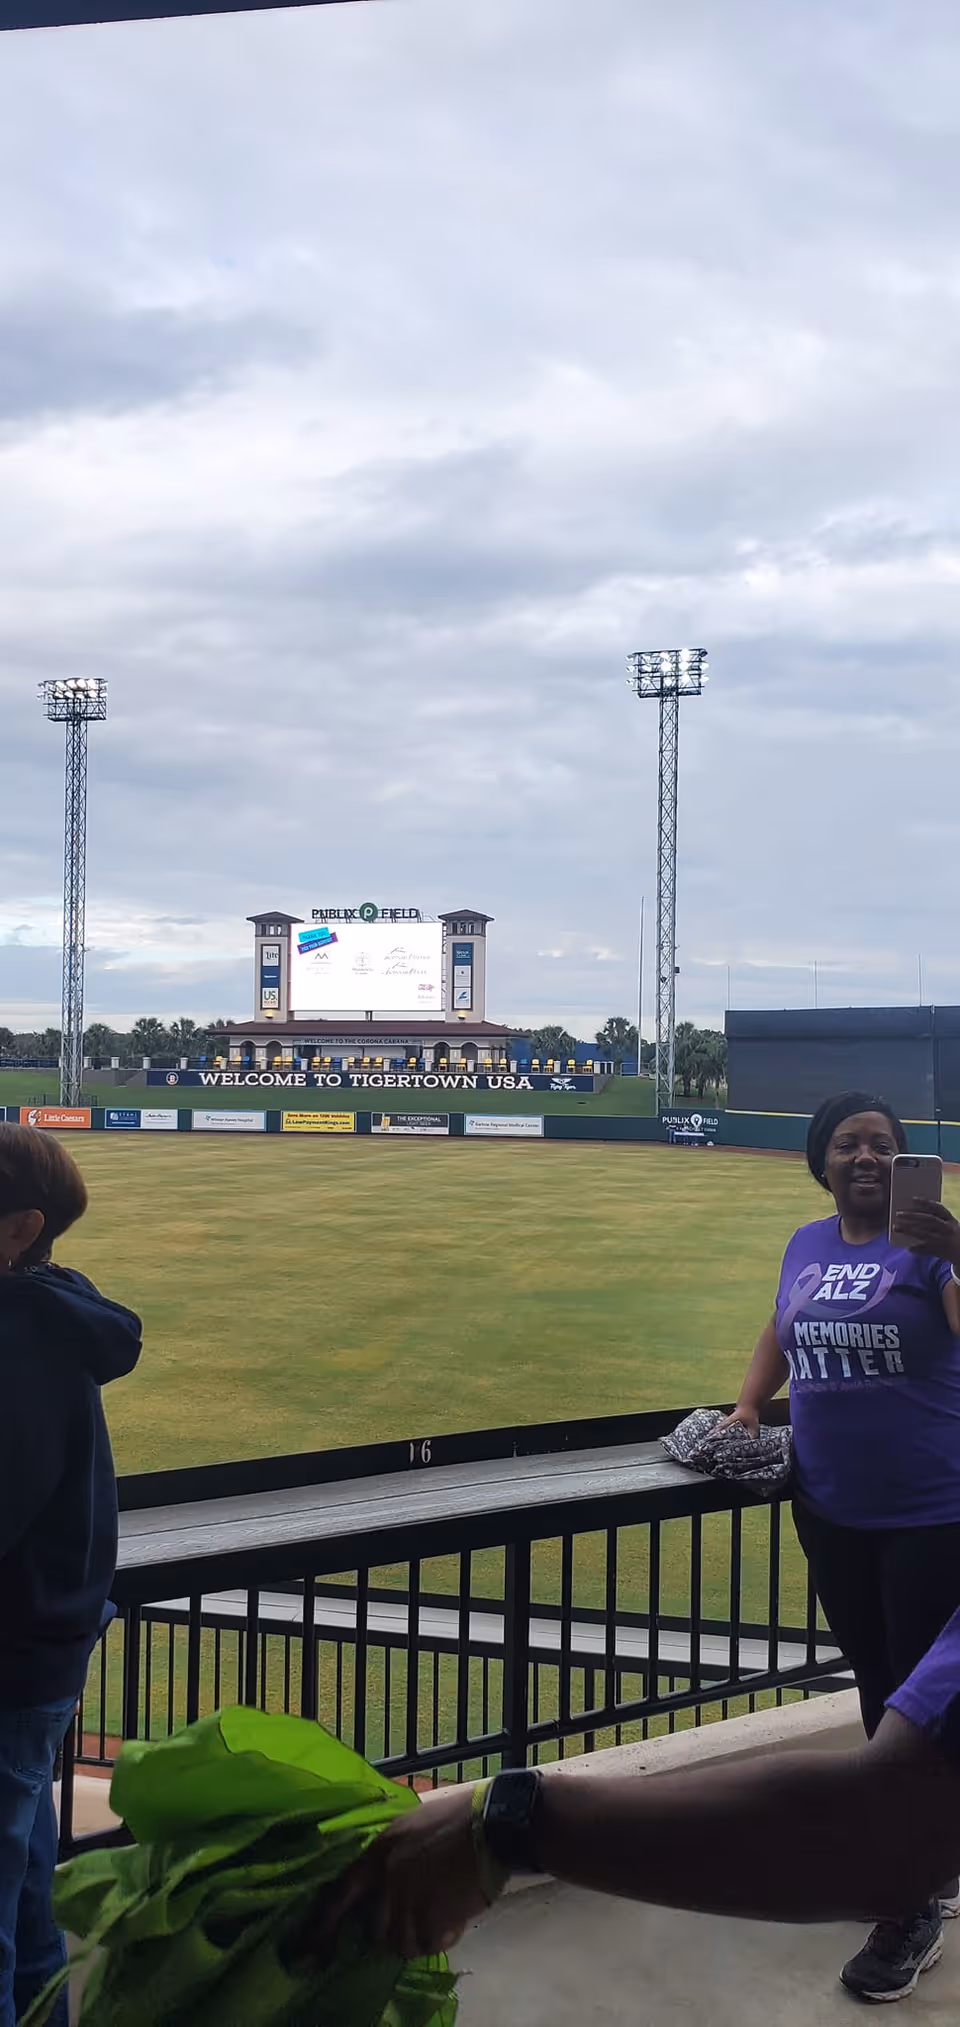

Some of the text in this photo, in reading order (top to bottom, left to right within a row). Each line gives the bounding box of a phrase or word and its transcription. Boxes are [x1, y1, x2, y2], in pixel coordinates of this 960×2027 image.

[312, 908, 357, 919] PUBLIX
[381, 908, 418, 919] FIELD
[199, 1072, 534, 1090] WELCOME TO TIGERTOWN USA
[44, 1113, 85, 1123] Little Caesars
[662, 1116, 719, 1125] PUBLIX FIELD
[821, 1262, 881, 1282] END
[812, 1280, 871, 1301] ALZ
[793, 1321, 900, 1349] MEMORIES
[409, 1439, 432, 1464] 16
